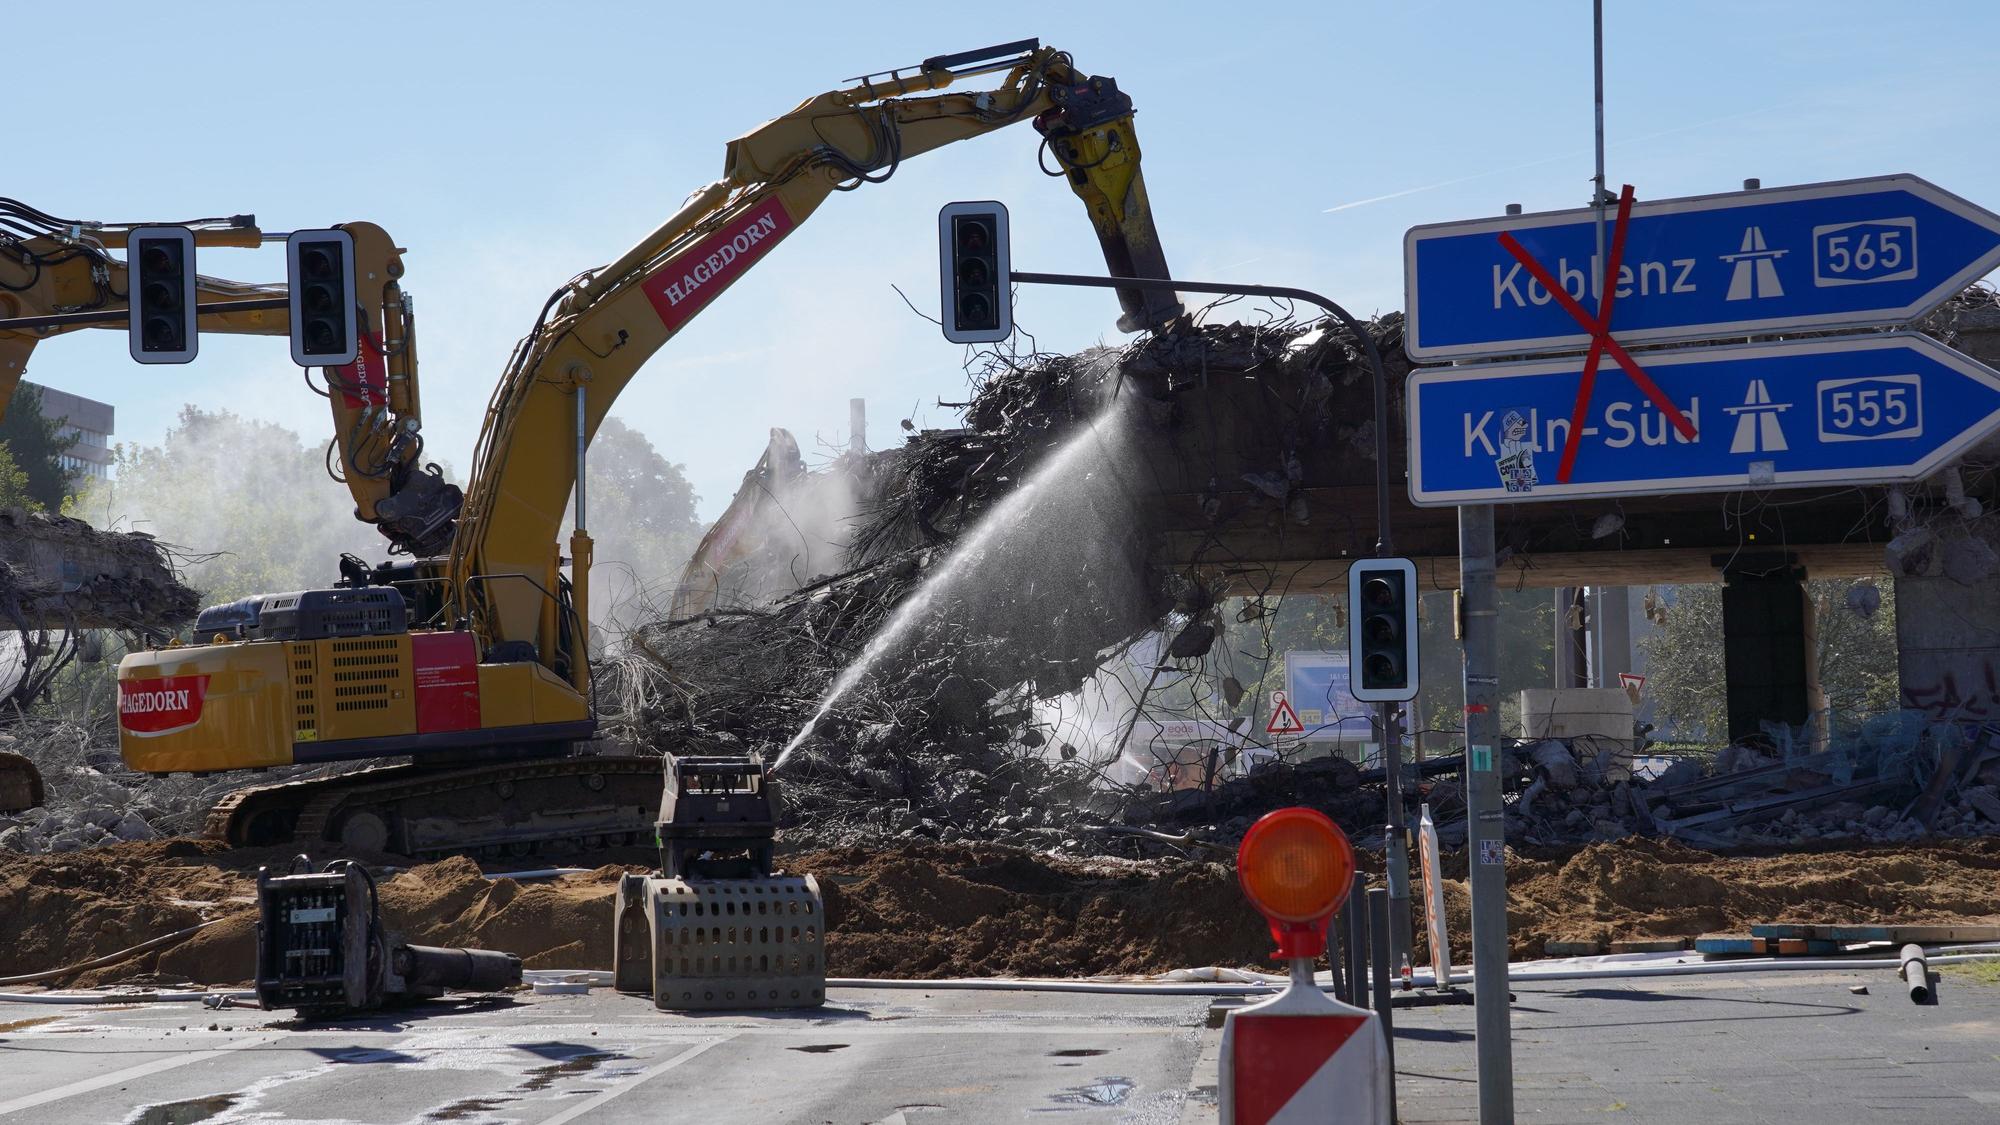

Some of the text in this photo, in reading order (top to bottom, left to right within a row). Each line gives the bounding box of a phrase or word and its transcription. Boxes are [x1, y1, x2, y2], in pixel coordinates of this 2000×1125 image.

[664, 212, 777, 306] HAGEDORN
[1828, 231, 1902, 273] 565
[1464, 388, 1907, 457] Kln-Süd 555
[122, 690, 189, 714] HAGEDORN
